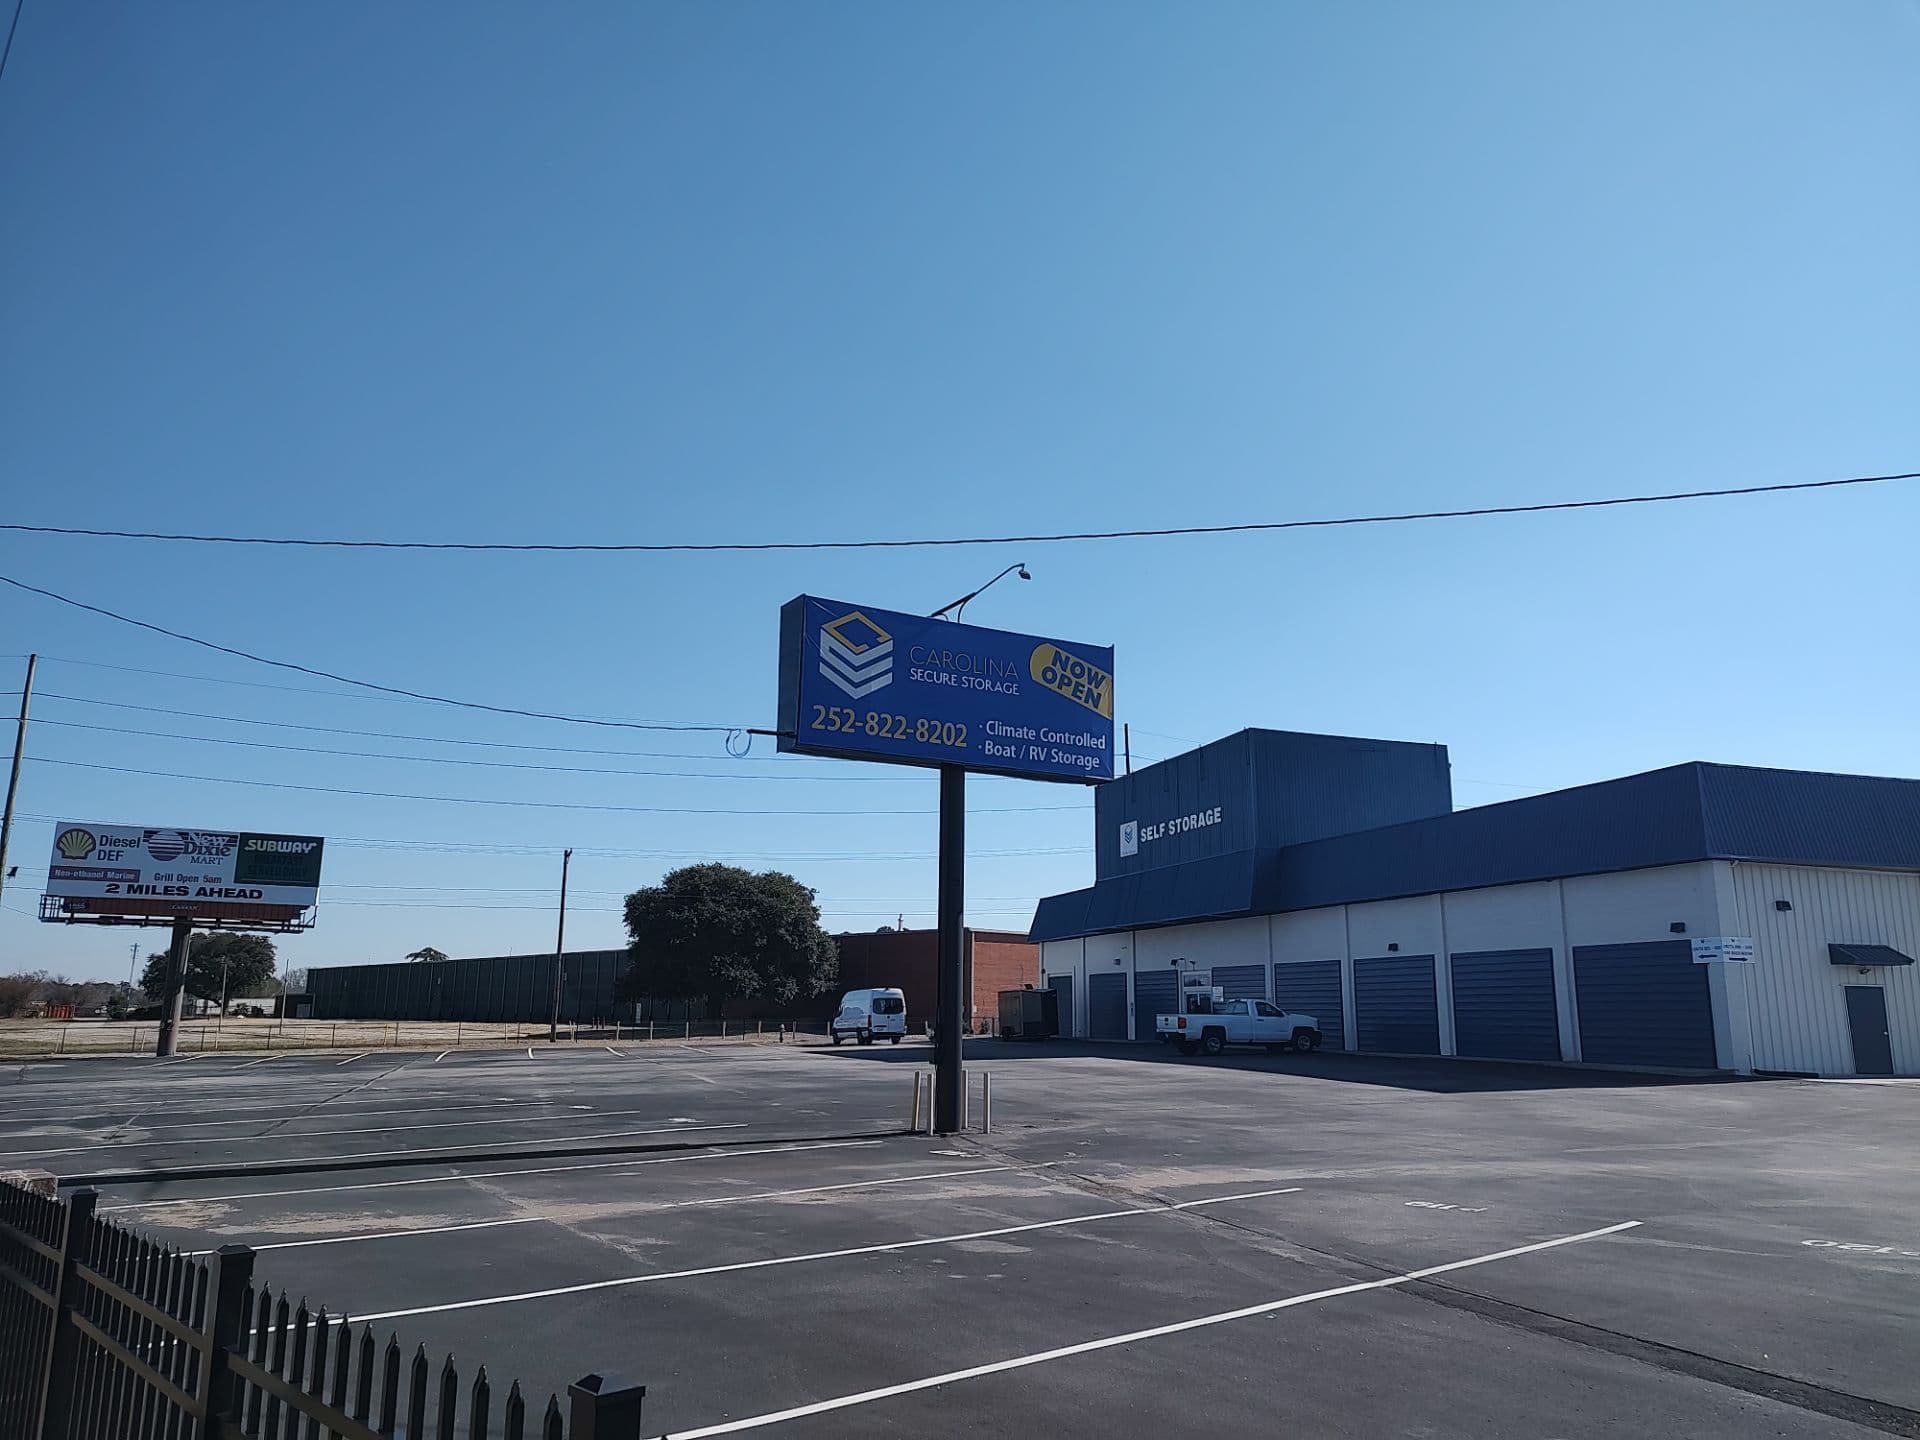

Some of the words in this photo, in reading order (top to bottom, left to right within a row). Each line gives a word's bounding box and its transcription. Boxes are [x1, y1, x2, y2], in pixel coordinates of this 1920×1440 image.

[909, 646, 1018, 678] CAROLINA
[1051, 651, 1106, 688] NOW
[910, 668, 958, 686] SECURE
[961, 676, 1020, 696] STORAGE
[1041, 668, 1103, 710] OPEN
[811, 704, 968, 748] 252-822-8202
[985, 720, 1036, 740] Climate
[1040, 727, 1106, 749] Controlled
[984, 741, 1017, 758] Boat
[1029, 745, 1047, 761] RV
[1050, 748, 1100, 769] Storage
[1141, 823, 1166, 842] SELF
[1168, 807, 1221, 835] STORAGE
[99, 834, 141, 849] Diesel
[182, 841, 231, 858] Dixie
[244, 839, 317, 855] SUBWAY
[97, 849, 124, 862] DEF
[190, 855, 224, 866] MART
[107, 871, 136, 881] Marine
[154, 872, 175, 883] Grill
[176, 874, 199, 885] Open
[203, 875, 222, 884] 5am
[105, 883, 120, 894] 2
[126, 884, 190, 897] MILES
[195, 886, 263, 899] AHEAD
